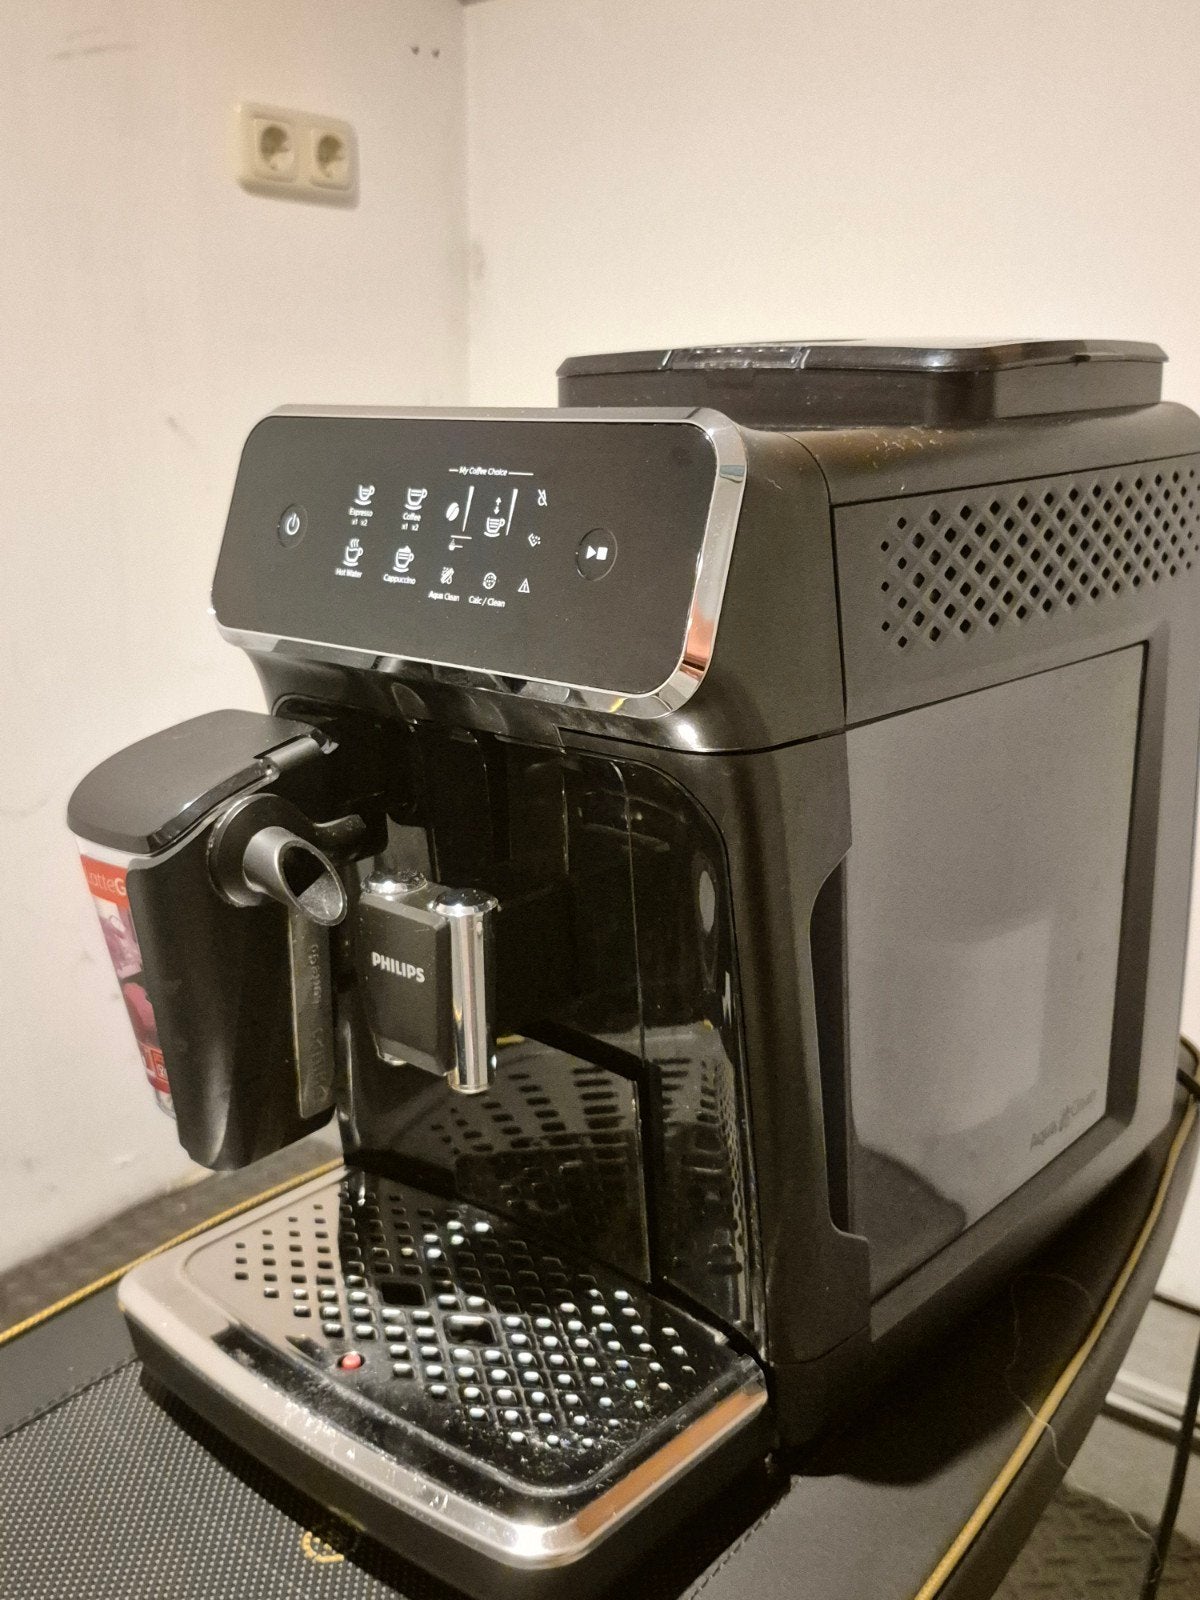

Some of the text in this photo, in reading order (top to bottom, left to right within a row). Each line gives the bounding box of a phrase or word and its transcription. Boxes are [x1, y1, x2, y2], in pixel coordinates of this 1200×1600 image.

[459, 465, 507, 477] My Coffee Choice
[348, 507, 373, 518] Espresso
[402, 512, 421, 522] Coffee
[351, 518, 368, 527] x1 x2
[401, 522, 419, 532] x1 x2
[335, 567, 362, 579] Hot Water
[383, 573, 417, 585] Cappuccino
[428, 590, 460, 602] Aqua Clean
[468, 595, 482, 605] Calc
[487, 597, 506, 608] Clean
[371, 951, 426, 983] PHILIPS
